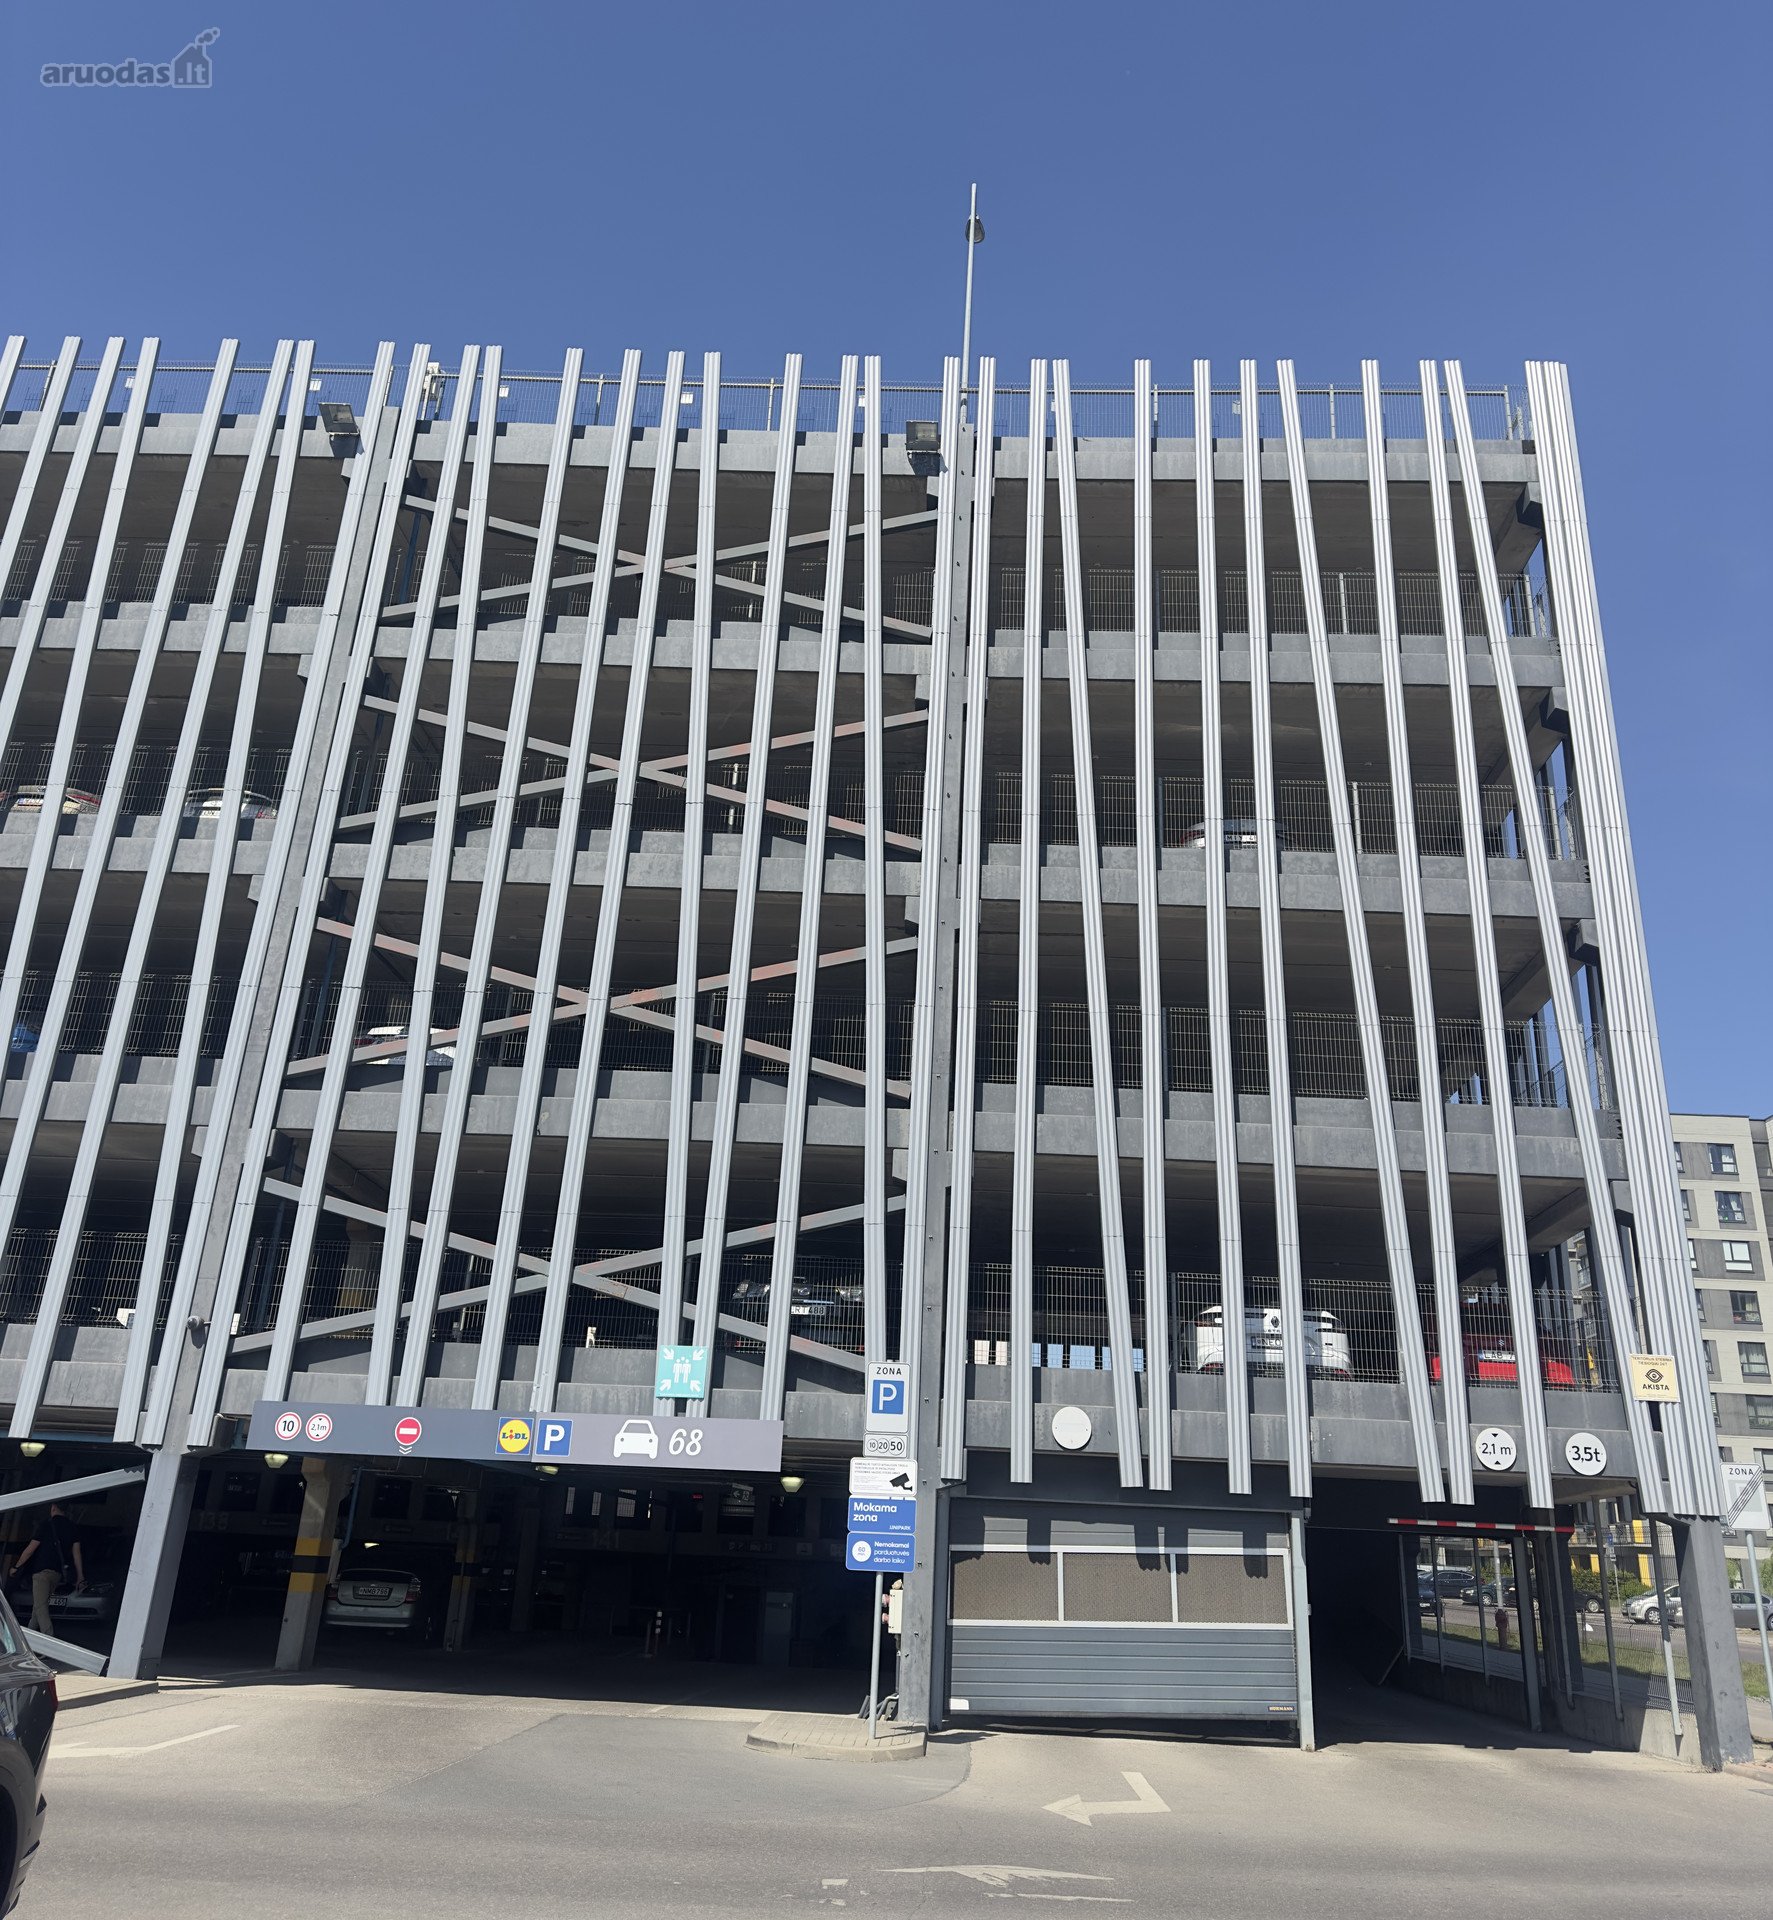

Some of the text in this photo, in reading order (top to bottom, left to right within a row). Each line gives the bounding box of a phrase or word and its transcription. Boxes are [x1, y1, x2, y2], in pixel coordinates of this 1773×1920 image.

[876, 1366, 902, 1375] ZONA
[1642, 1383, 1670, 1391] AKISTA
[878, 1383, 898, 1411] P
[282, 1420, 295, 1432] 10
[543, 1424, 565, 1451] P
[669, 1428, 703, 1456] 68
[878, 1442, 888, 1450] 20
[890, 1441, 903, 1451] 50
[1481, 1442, 1512, 1455] 2,1 m
[1729, 1467, 1754, 1475] ZONA
[853, 1502, 897, 1513] Mokama
[853, 1514, 878, 1522] zona
[874, 1541, 910, 1549] Nemokamai
